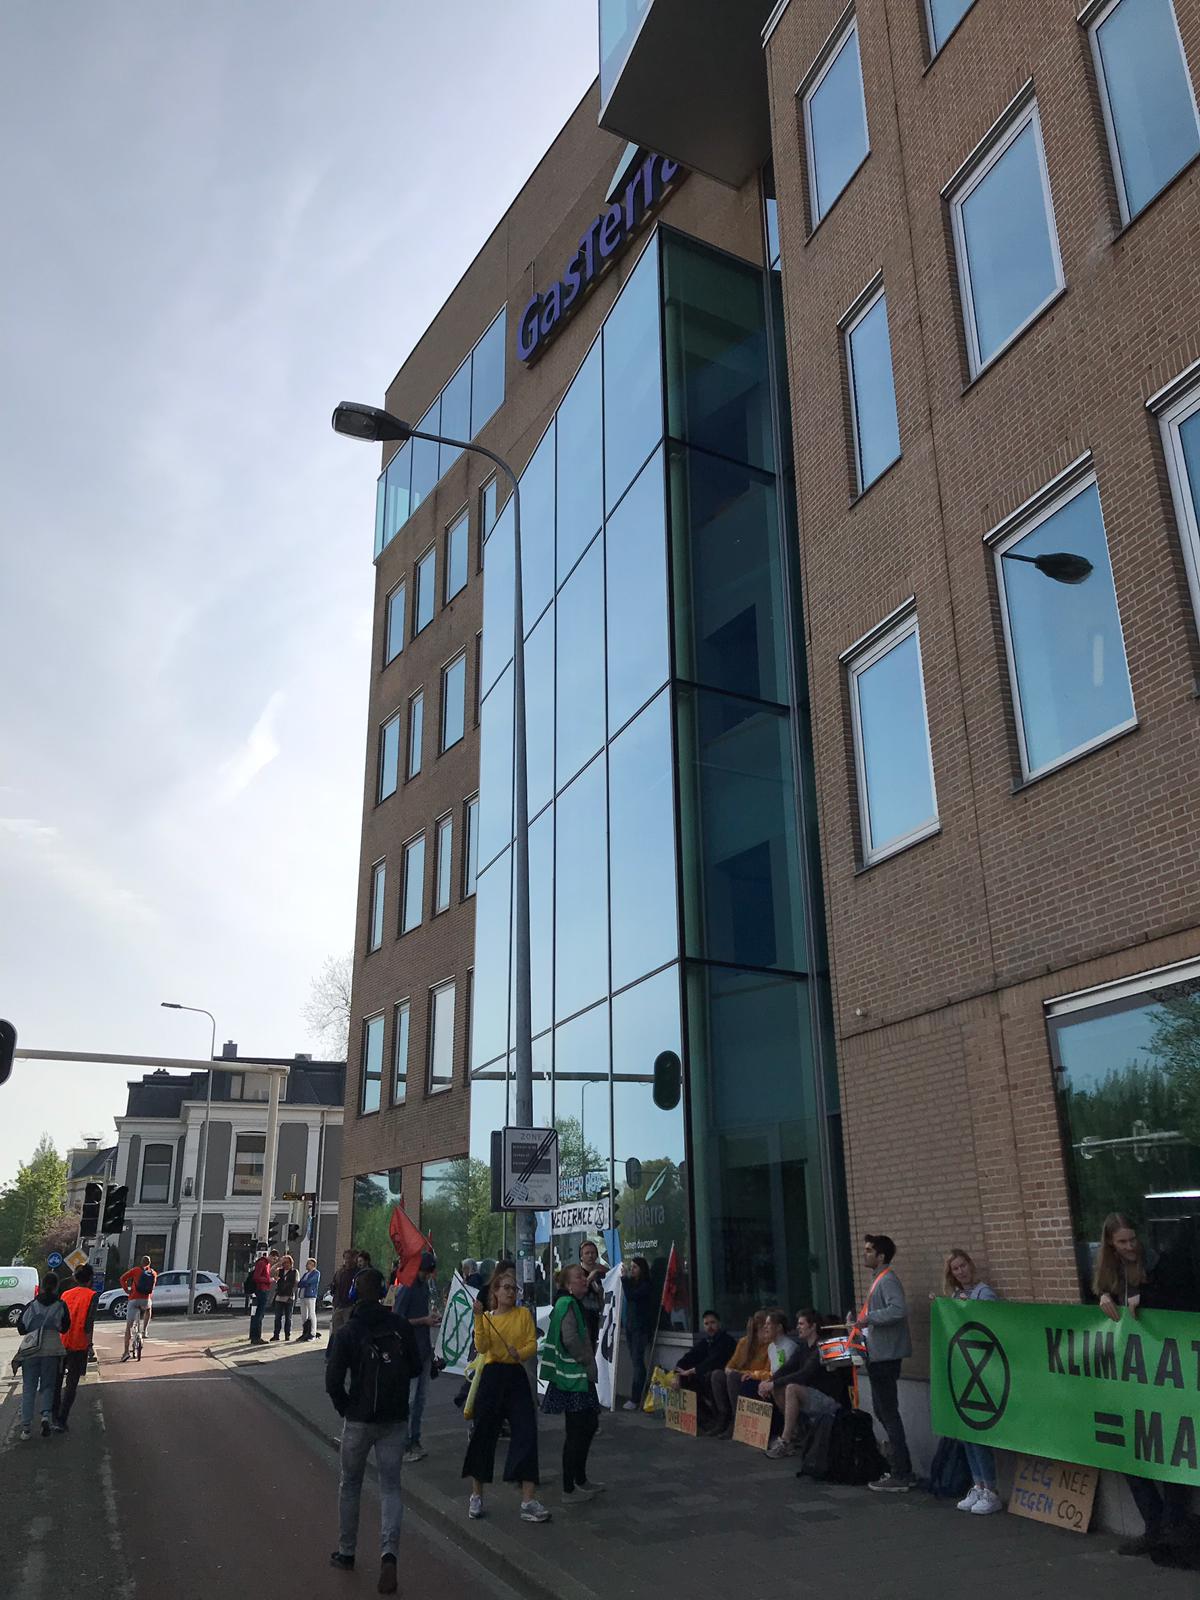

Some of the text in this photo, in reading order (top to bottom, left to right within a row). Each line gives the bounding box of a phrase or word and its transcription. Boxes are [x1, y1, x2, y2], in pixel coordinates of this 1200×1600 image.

[1020, 1462, 1090, 1496] ZEG NEE
[1015, 1487, 1053, 1514] TEGEN
